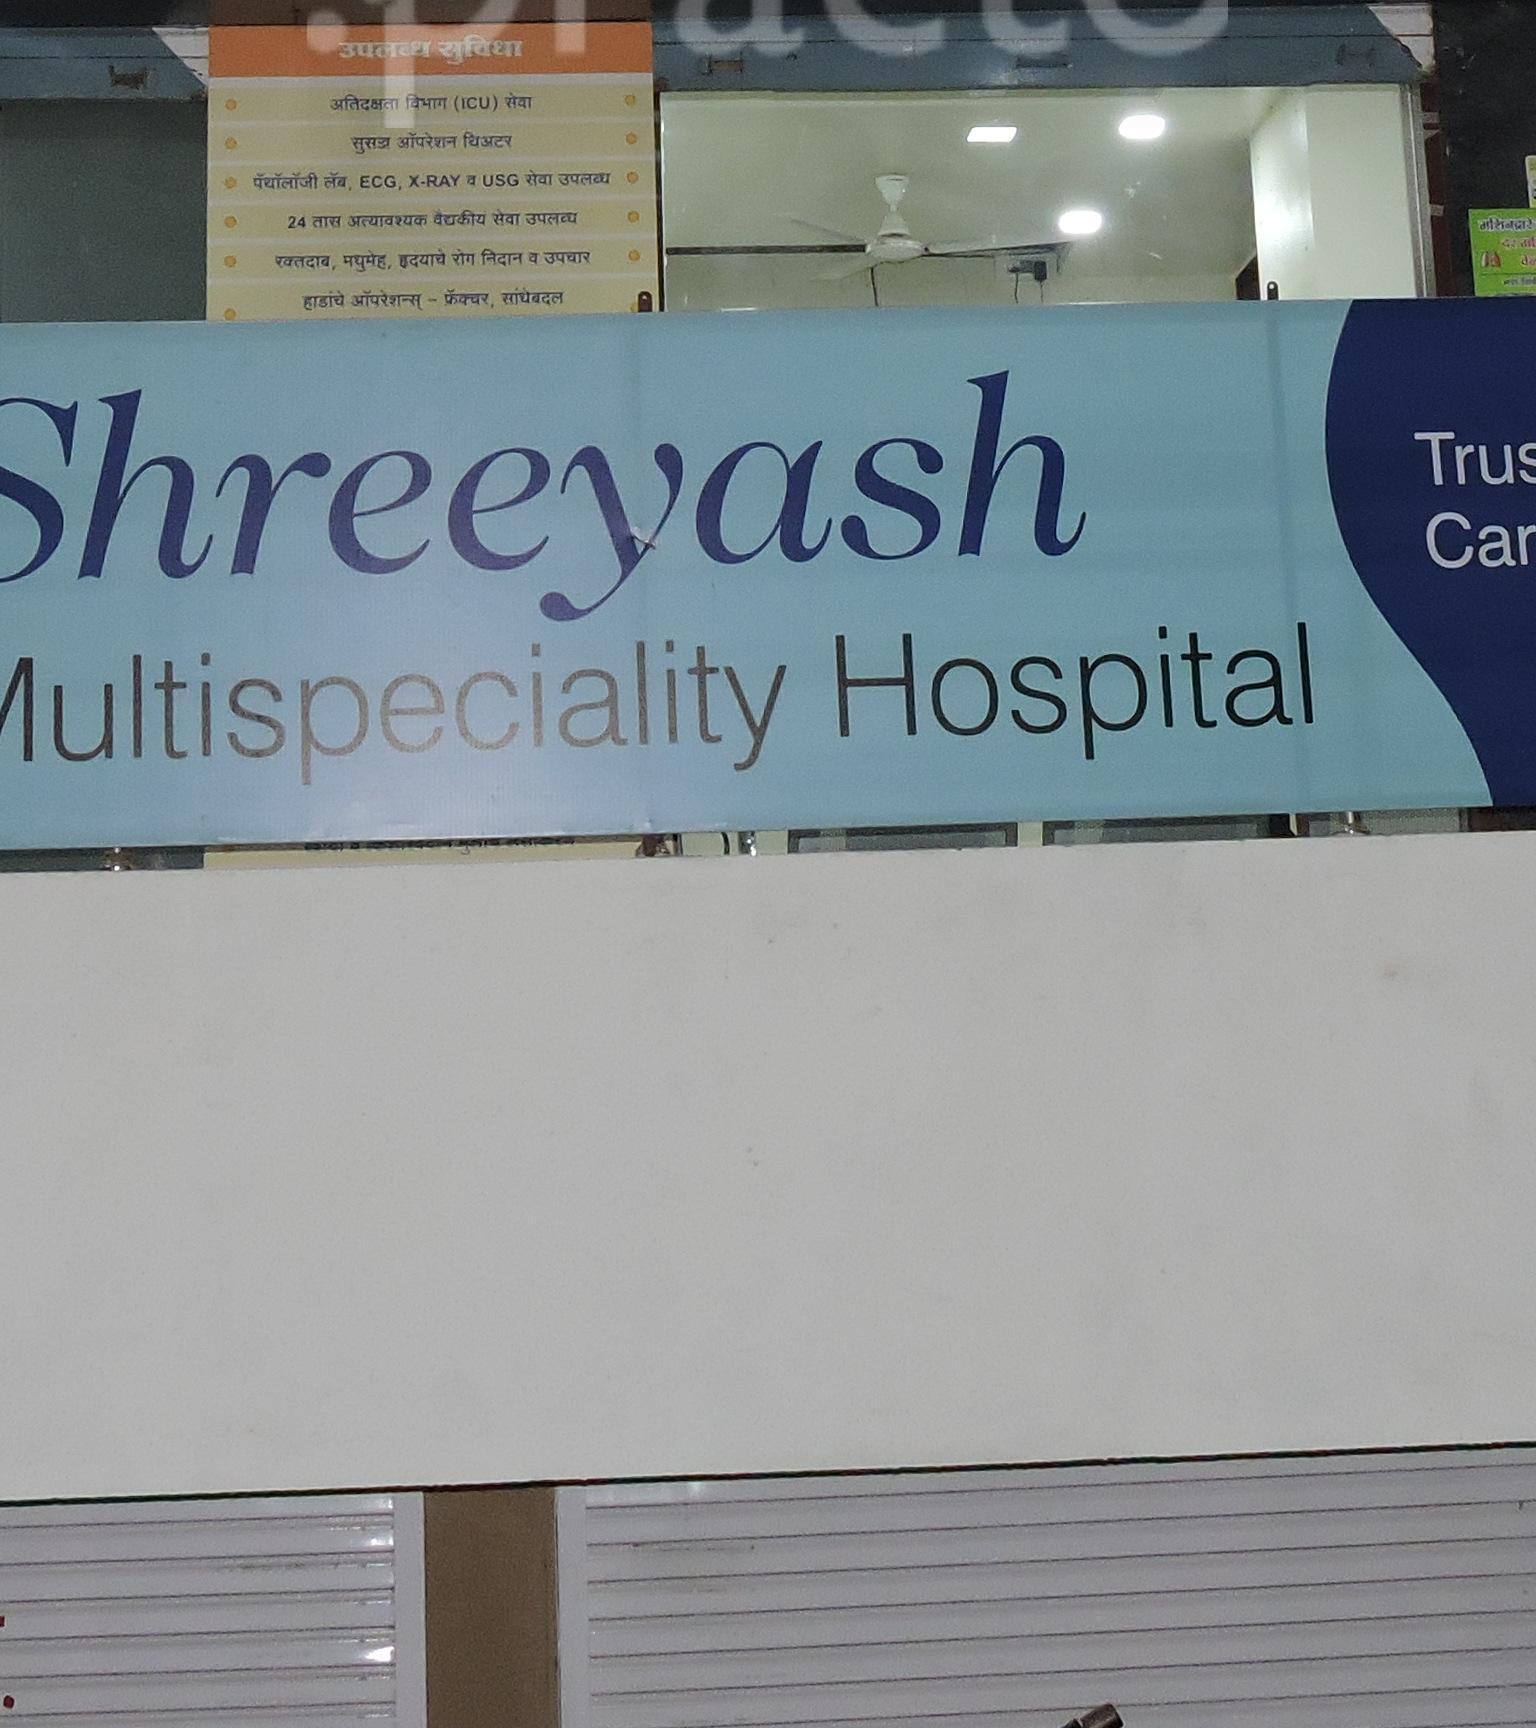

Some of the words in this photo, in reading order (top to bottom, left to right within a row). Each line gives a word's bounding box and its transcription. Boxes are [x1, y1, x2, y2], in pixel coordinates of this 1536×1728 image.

[453, 95, 498, 113] (ICU)
[504, 92, 532, 110] सेवा
[359, 174, 402, 191] ECG,
[408, 174, 461, 189] X-RAY
[482, 173, 520, 188] USG
[525, 169, 553, 187] सेवा
[287, 215, 306, 230] 24
[312, 215, 341, 229] तास
[492, 207, 521, 226] सेवा
[451, 248, 476, 266] रोग
[480, 247, 523, 267] निदान
[543, 250, 591, 265] उपचार
[835, 621, 1316, 760] Hospital
